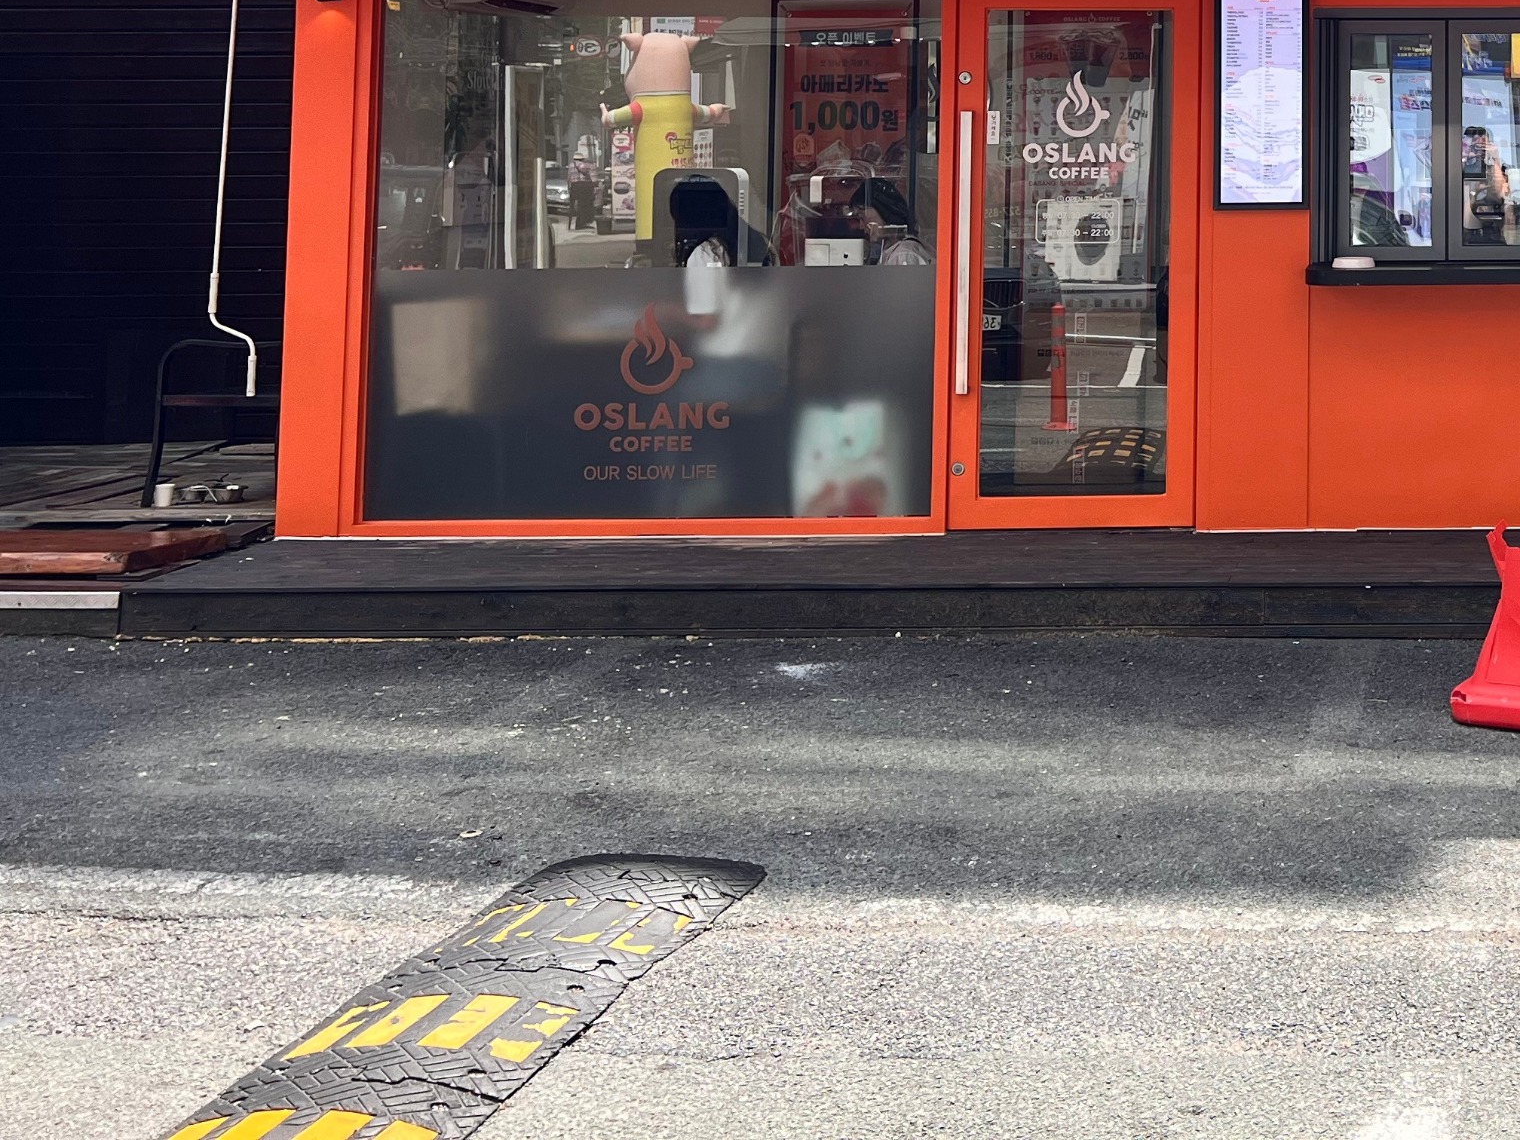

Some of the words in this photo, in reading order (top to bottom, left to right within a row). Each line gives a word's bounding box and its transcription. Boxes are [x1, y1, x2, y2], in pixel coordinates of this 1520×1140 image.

[816, 32, 838, 45] 오픈
[842, 32, 876, 45] 이벤트
[801, 74, 889, 94] 아메리카노
[789, 100, 899, 135] 1,000원
[1022, 142, 1136, 164] OSLANG
[1049, 167, 1109, 179] COFFEE
[573, 401, 730, 431] OSLANG
[609, 435, 693, 452] COFFEE
[583, 465, 620, 481] OUR
[626, 464, 676, 480] SLOW
[682, 464, 717, 480] LIFE
